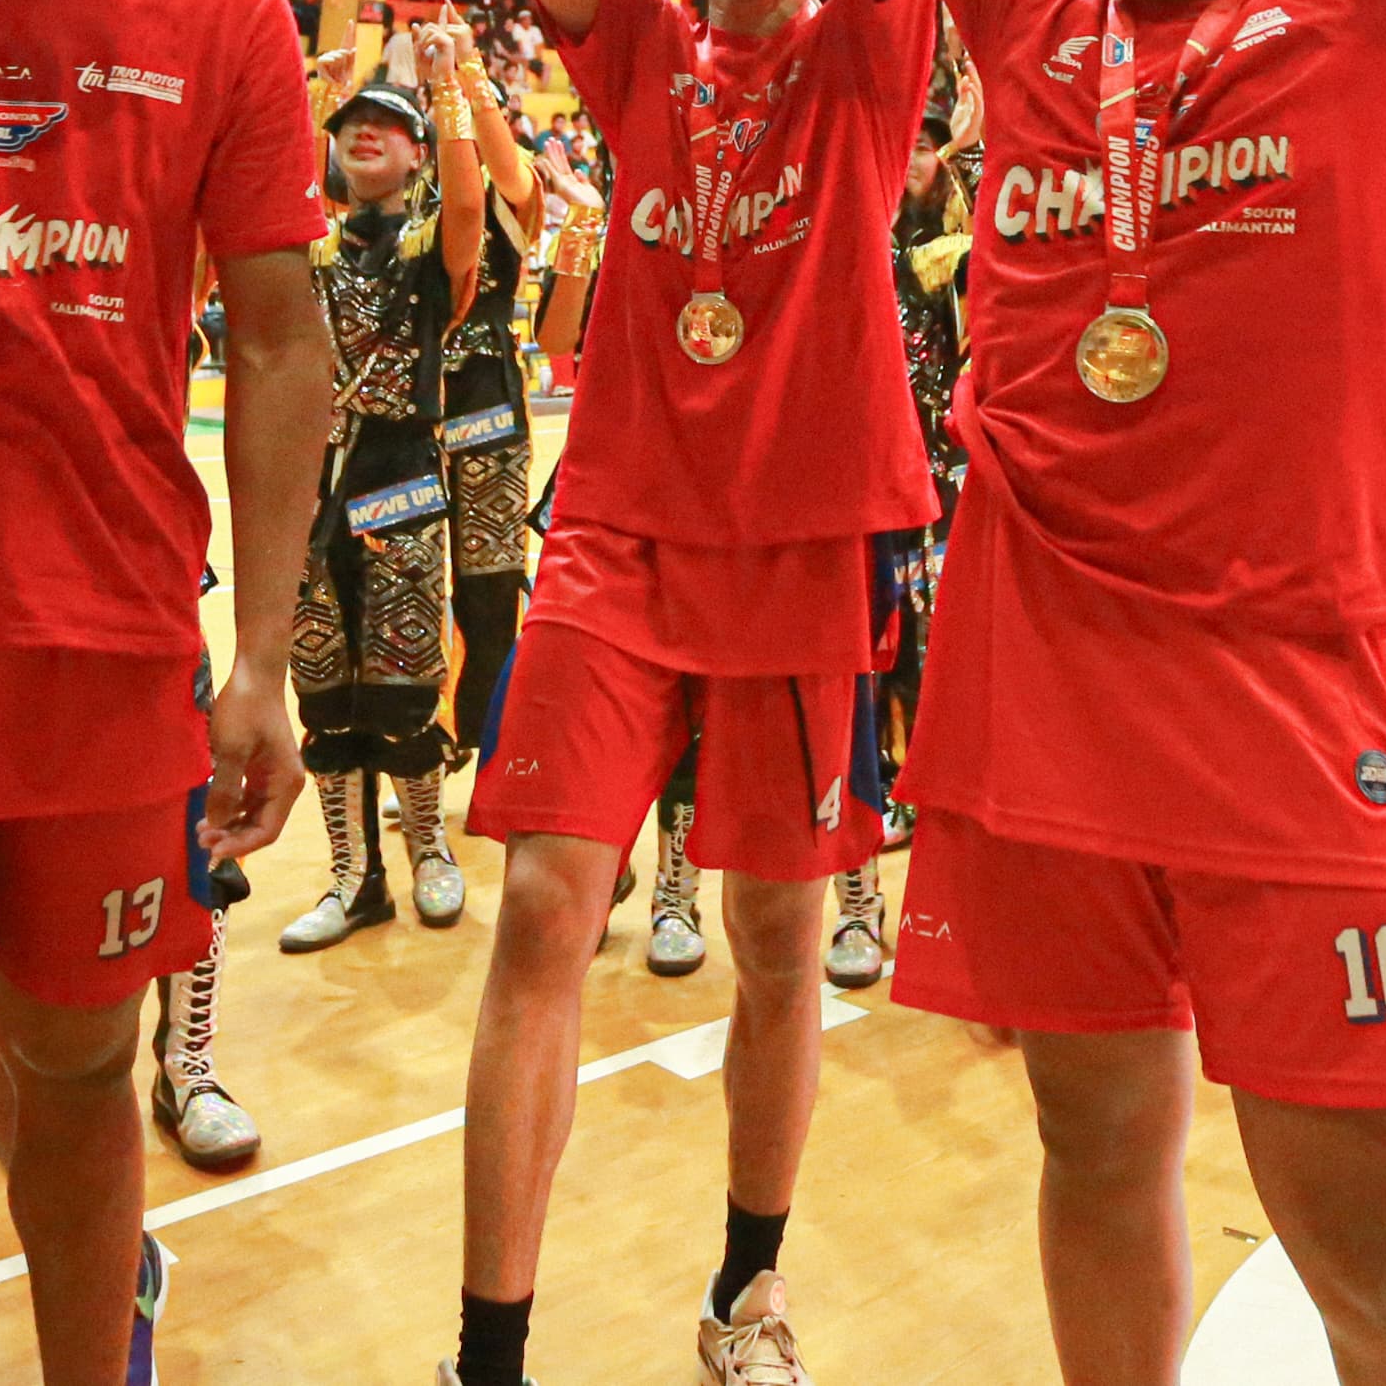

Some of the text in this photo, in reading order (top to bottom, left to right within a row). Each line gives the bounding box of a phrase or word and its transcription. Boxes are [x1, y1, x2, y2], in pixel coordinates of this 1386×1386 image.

[111, 64, 141, 80] TRIO
[141, 70, 186, 90] MOTOR
[994, 134, 1291, 242] CHPION
[1107, 134, 1137, 253] CHAMPION
[702, 170, 733, 263] CHAMPION
[1196, 221, 1296, 236] ALIMANTAN
[1242, 207, 1296, 221] SOUTH
[446, 418, 493, 444] MOVE
[349, 484, 445, 526] MOVE UP!
[816, 774, 843, 833] 4
[98, 876, 166, 958] 13
